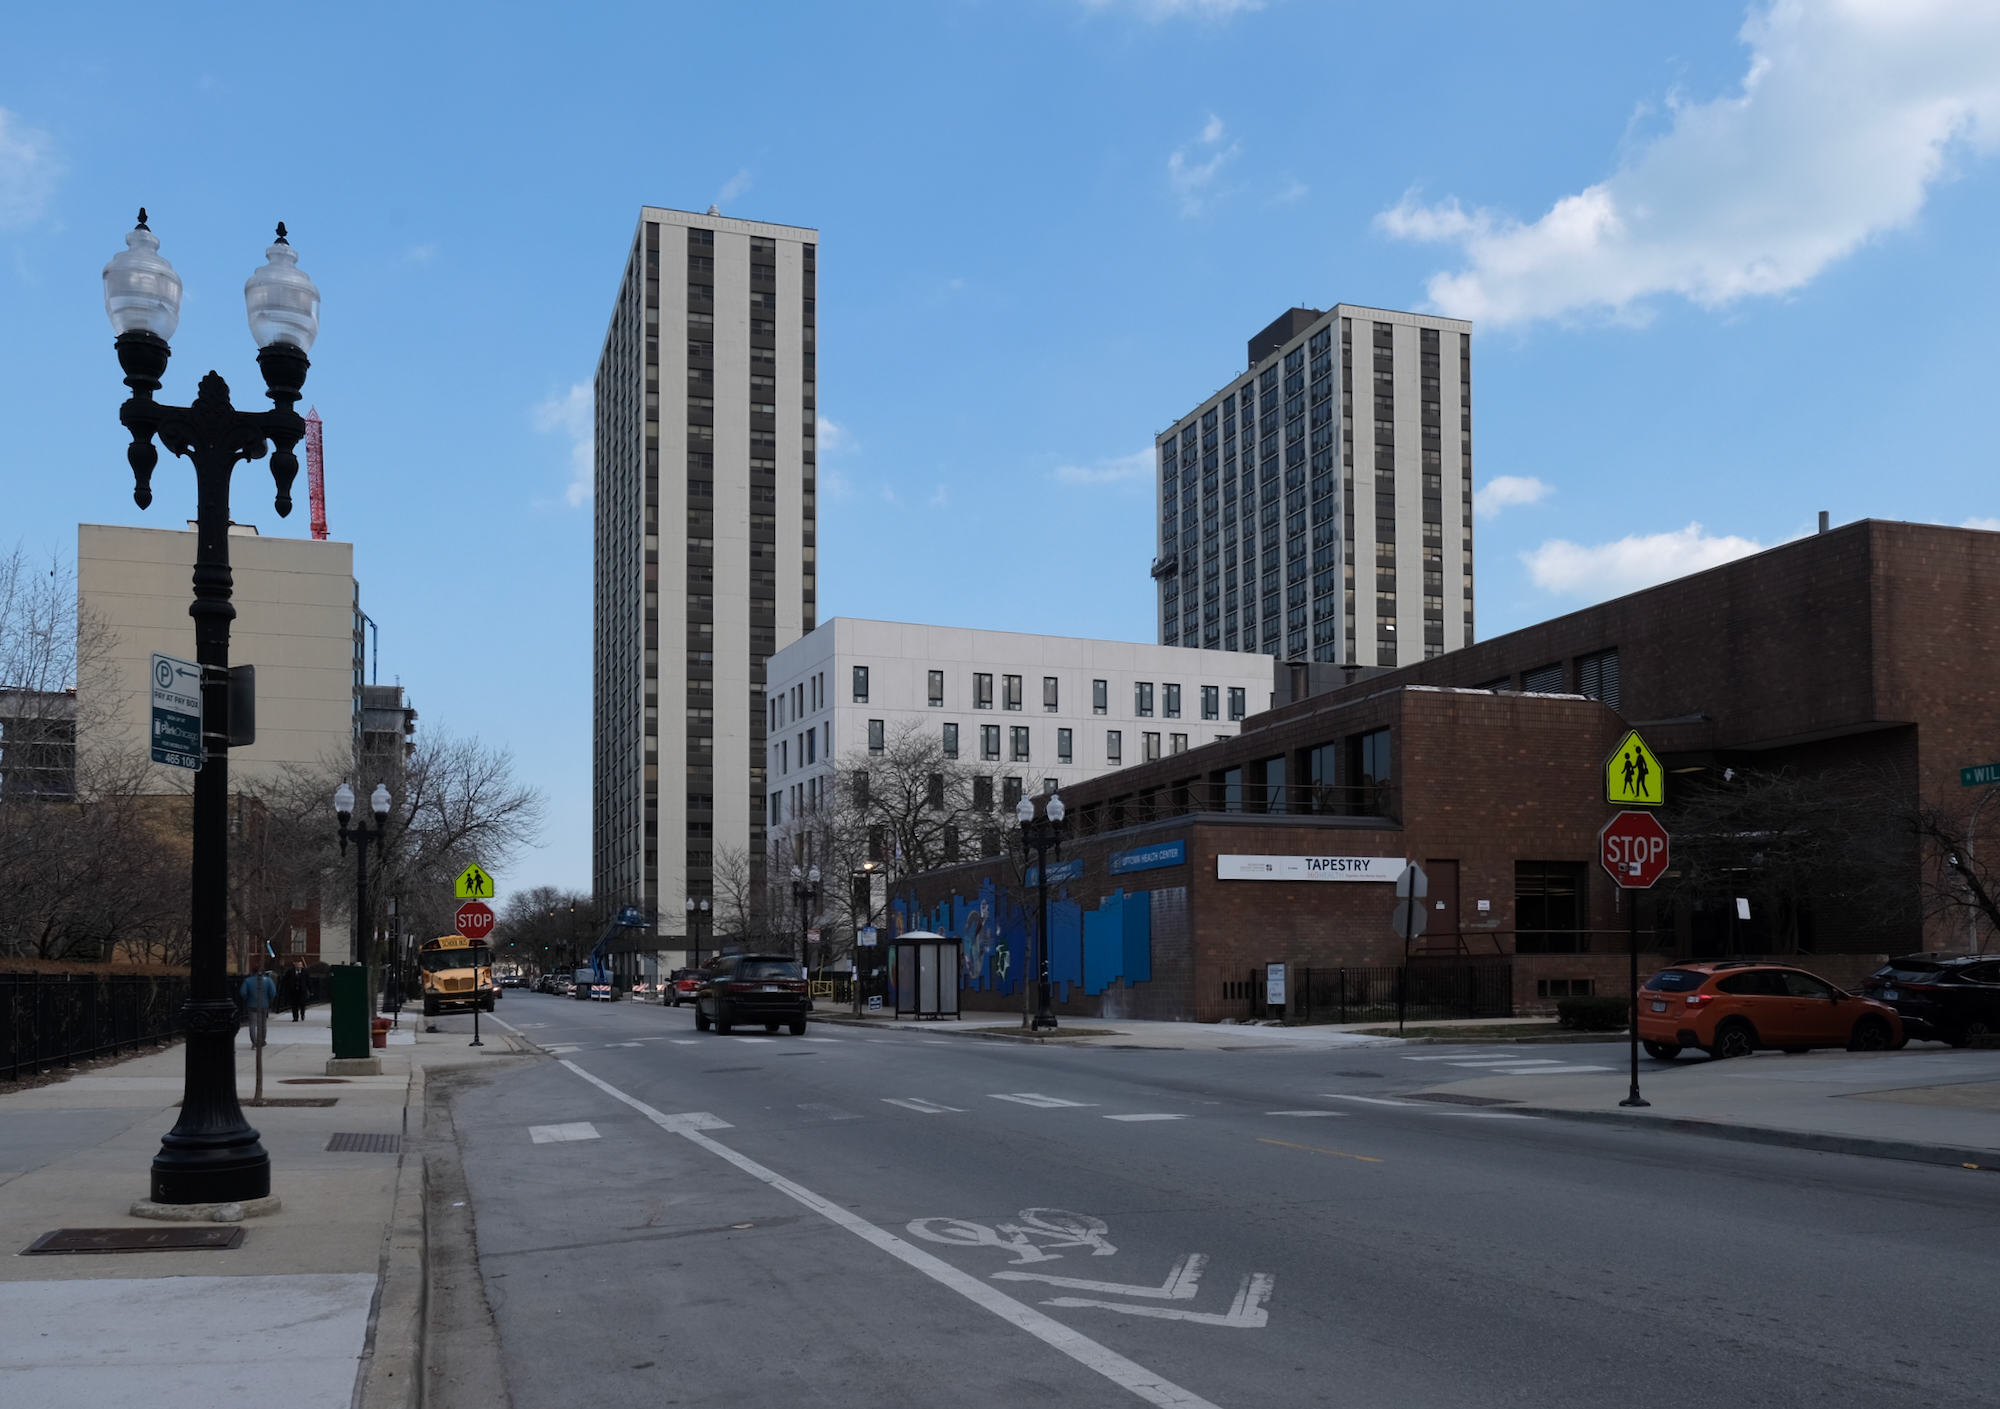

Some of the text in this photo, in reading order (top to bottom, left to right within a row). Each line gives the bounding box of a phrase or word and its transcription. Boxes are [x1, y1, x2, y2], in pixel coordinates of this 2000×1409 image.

[161, 665, 169, 682] P
[154, 691, 199, 708] PAY AT PAY BOX
[165, 753, 180, 764] 465
[181, 756, 196, 768] 106
[1973, 766, 2000, 782] WIL
[1141, 852, 1158, 863] HEALTH
[1159, 848, 1178, 860] CENTER
[1607, 835, 1664, 864] STOP
[1305, 858, 1371, 871] TAPESTRY
[458, 913, 492, 928] STOP
